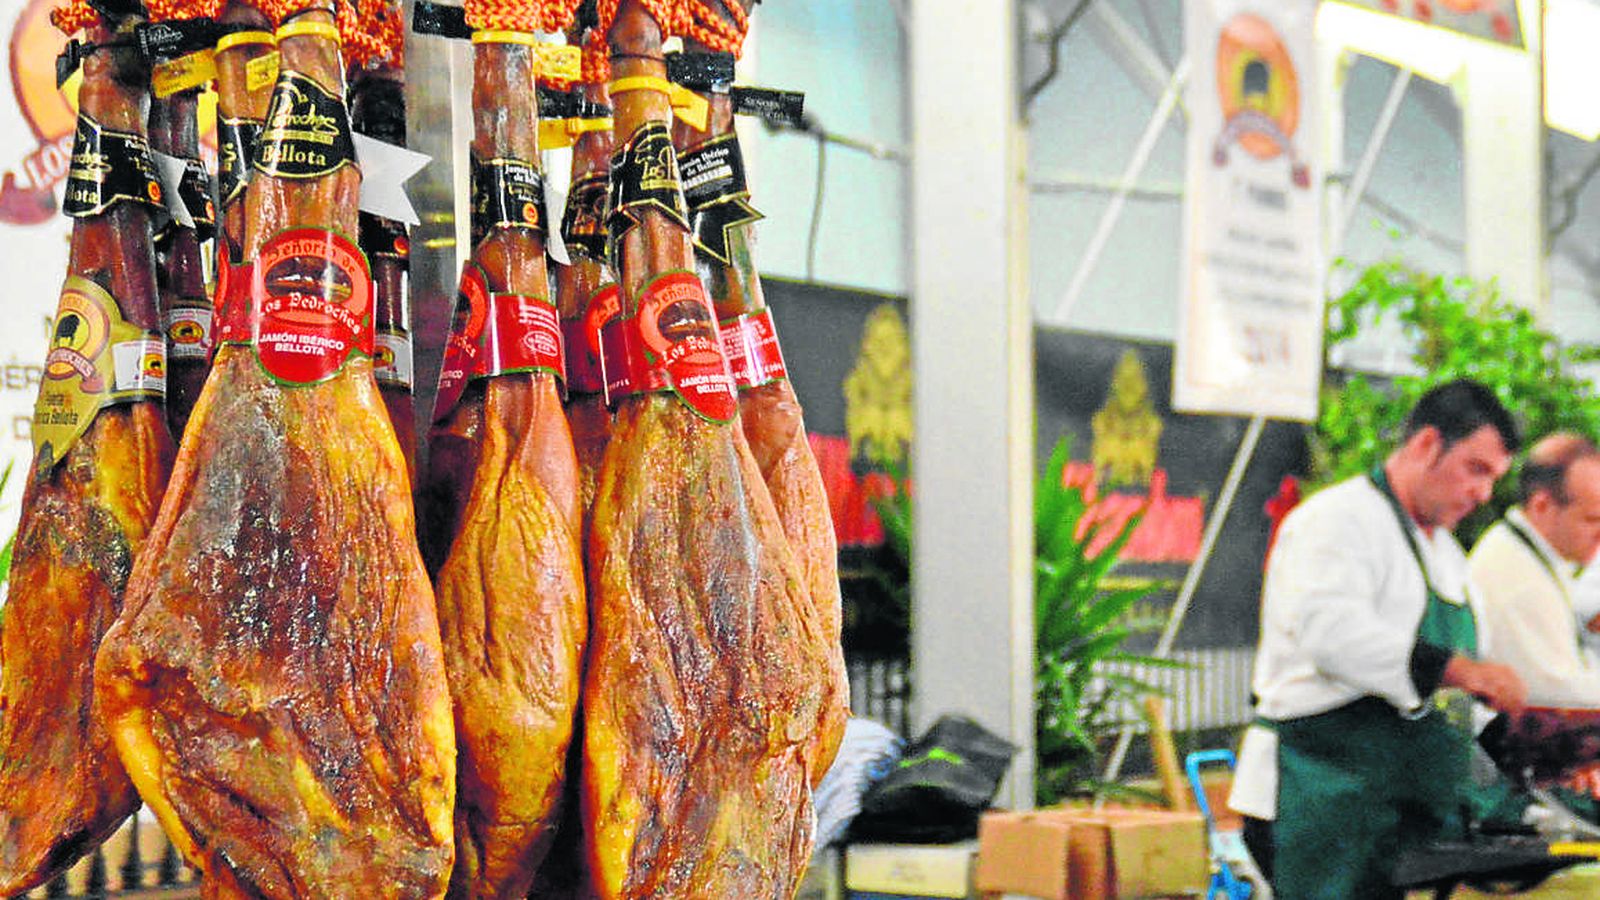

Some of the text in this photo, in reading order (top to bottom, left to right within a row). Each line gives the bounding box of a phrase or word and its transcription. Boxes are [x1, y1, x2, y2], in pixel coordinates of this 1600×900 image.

[288, 291, 362, 335] Pedroches
[259, 332, 346, 351] JAMÓN IBÉRICO
[274, 342, 326, 357] BELLOTA
